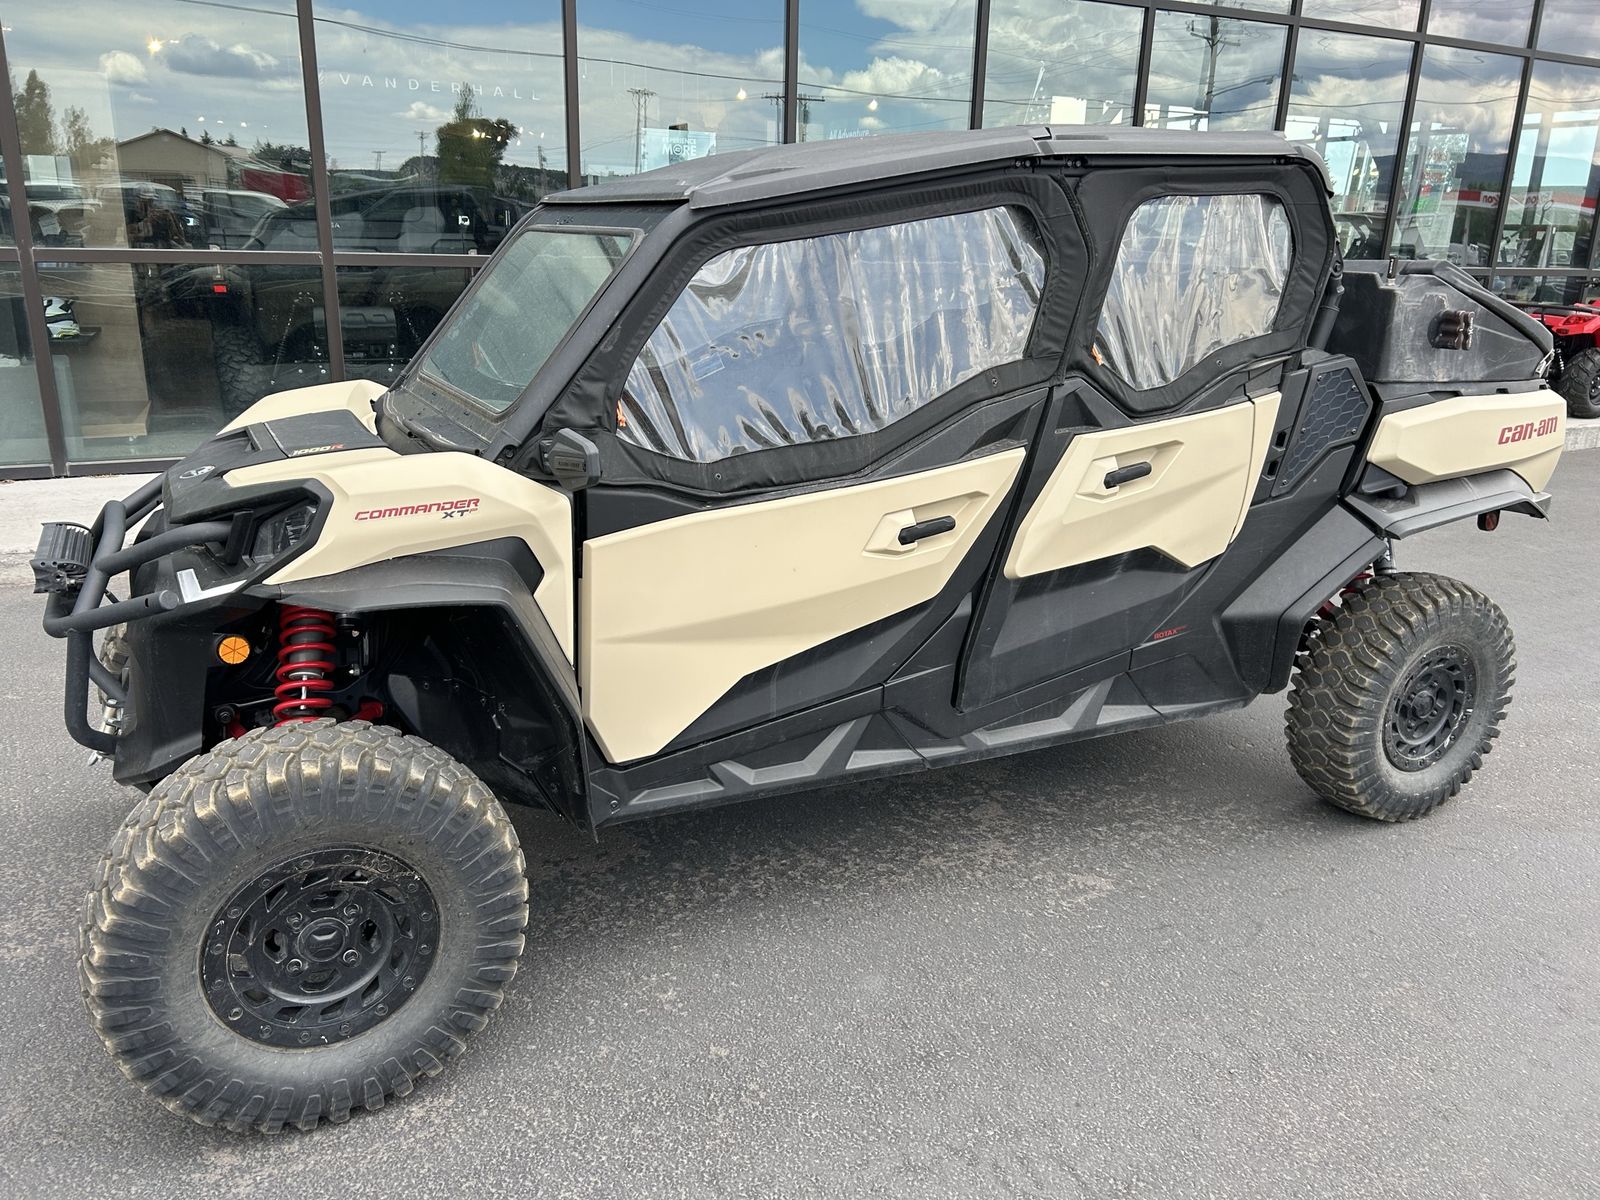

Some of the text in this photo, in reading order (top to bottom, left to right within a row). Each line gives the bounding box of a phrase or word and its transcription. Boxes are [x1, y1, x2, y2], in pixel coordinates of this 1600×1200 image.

[339, 73, 540, 101] VANDERHALL
[662, 143, 697, 157] MORE
[354, 498, 480, 521] COMMANDER
